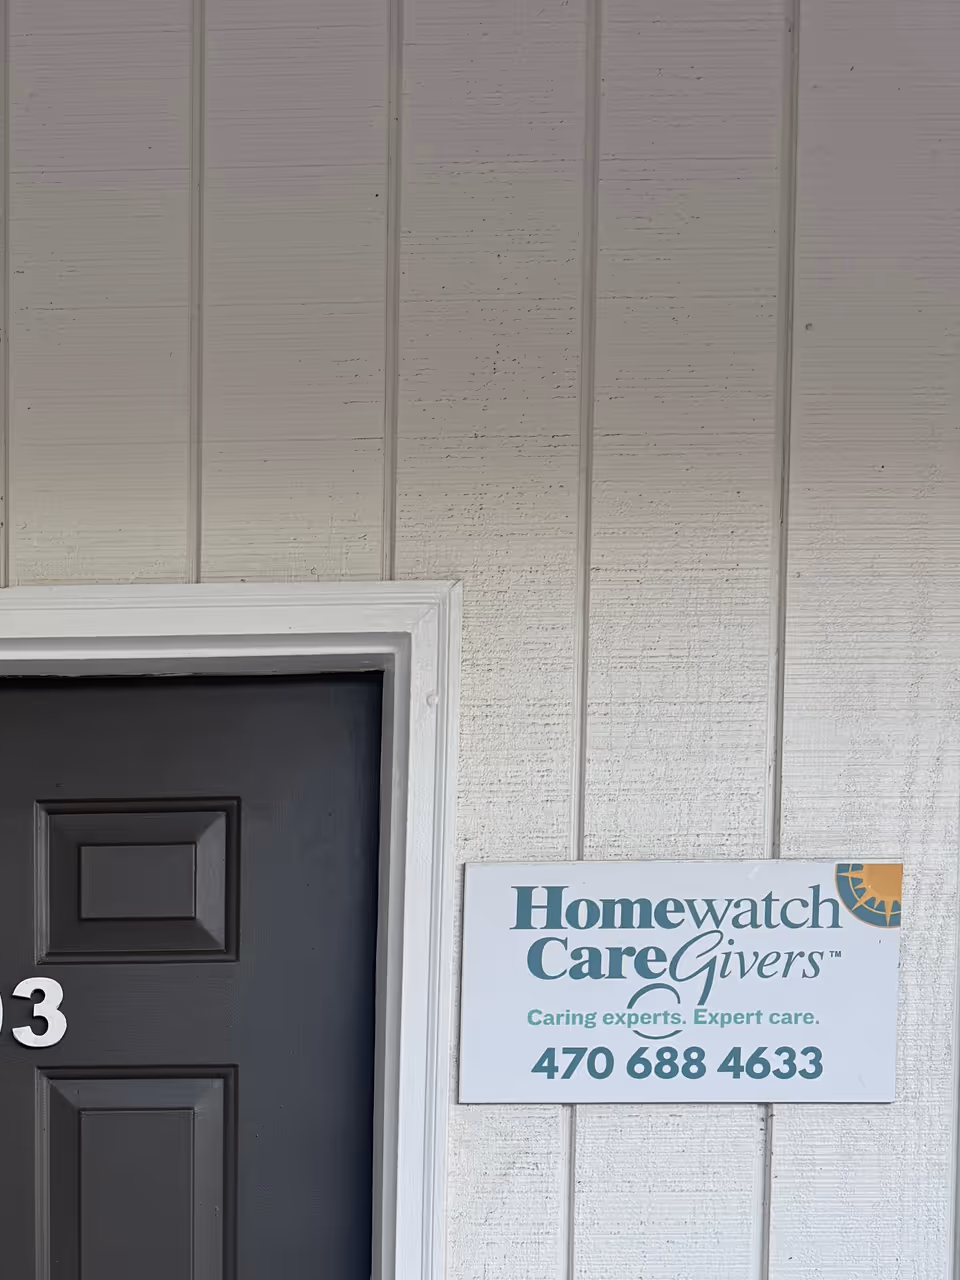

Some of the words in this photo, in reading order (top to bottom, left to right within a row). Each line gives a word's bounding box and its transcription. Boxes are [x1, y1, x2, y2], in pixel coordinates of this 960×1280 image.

[510, 884, 843, 930] Homewatch
[527, 1009, 597, 1029] Caring
[602, 1010, 687, 1028] experts.
[693, 1008, 763, 1027] Expert
[769, 1010, 820, 1027] care.
[531, 1047, 615, 1080] 470
[626, 1046, 707, 1080] 688
[717, 1046, 823, 1080] 4633
